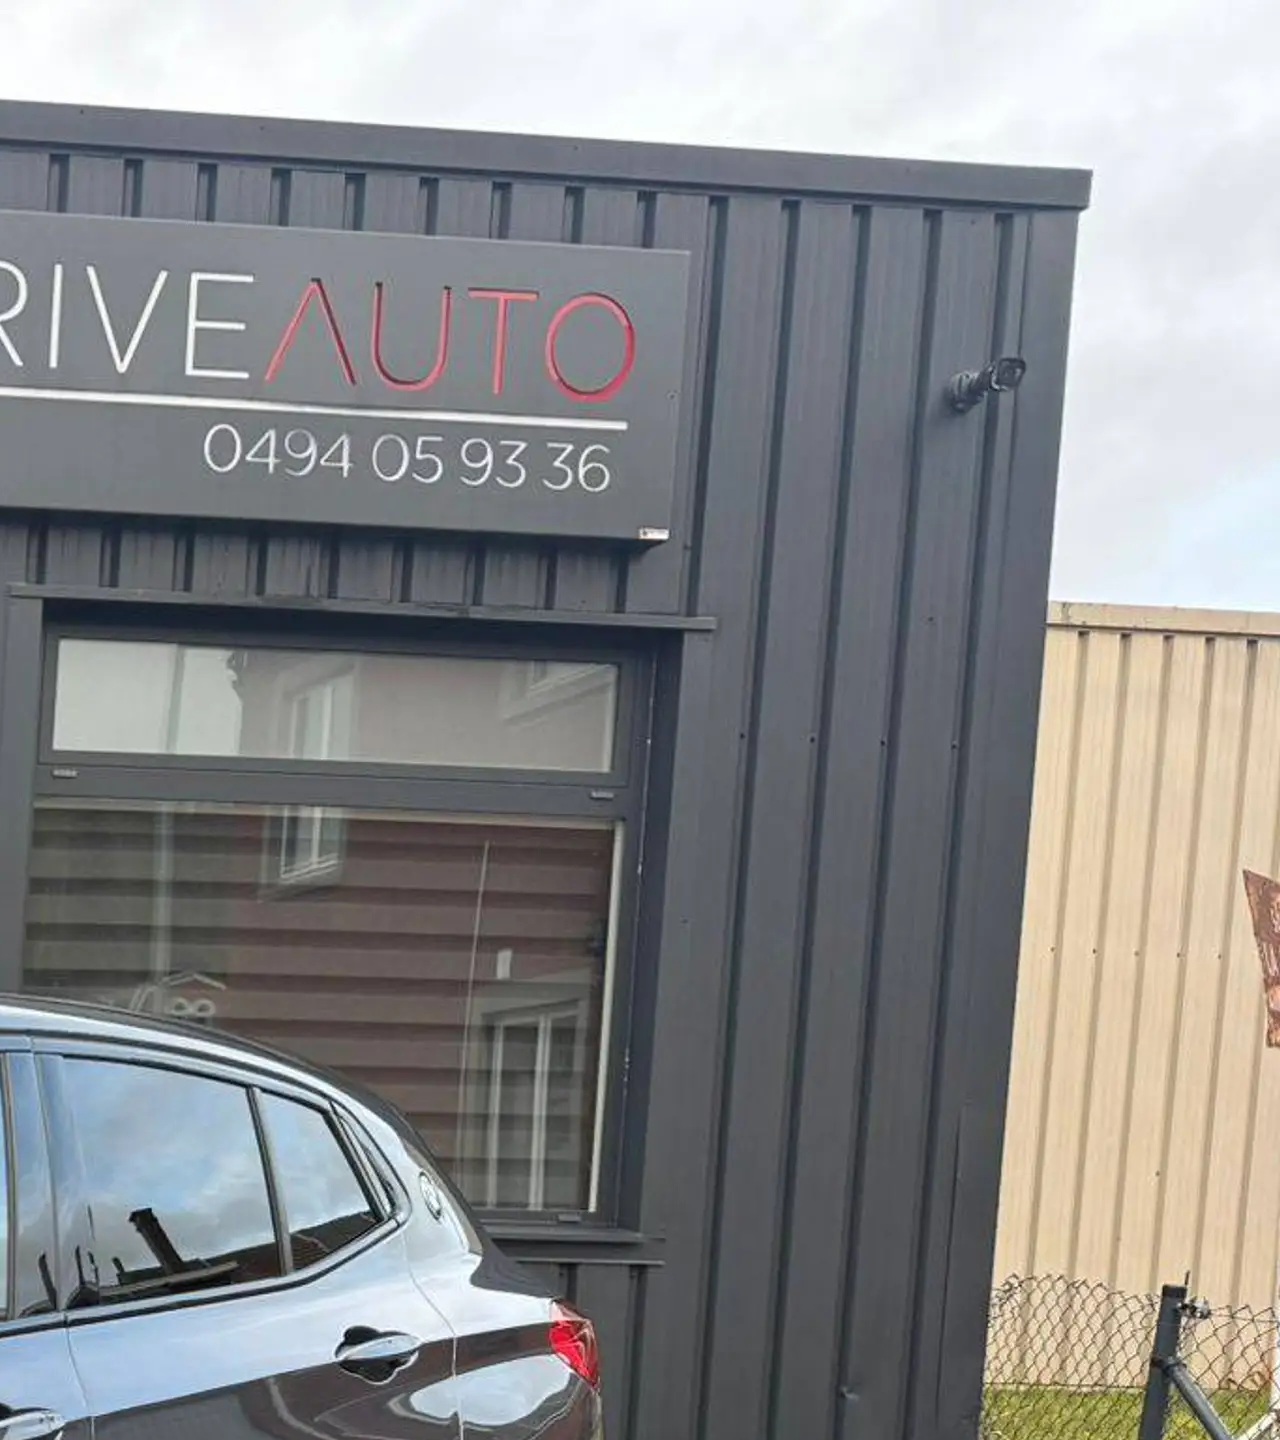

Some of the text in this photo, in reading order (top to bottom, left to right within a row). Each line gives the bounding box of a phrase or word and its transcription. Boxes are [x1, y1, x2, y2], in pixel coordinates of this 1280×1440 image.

[204, 423, 611, 493] 0494 05 93 36
